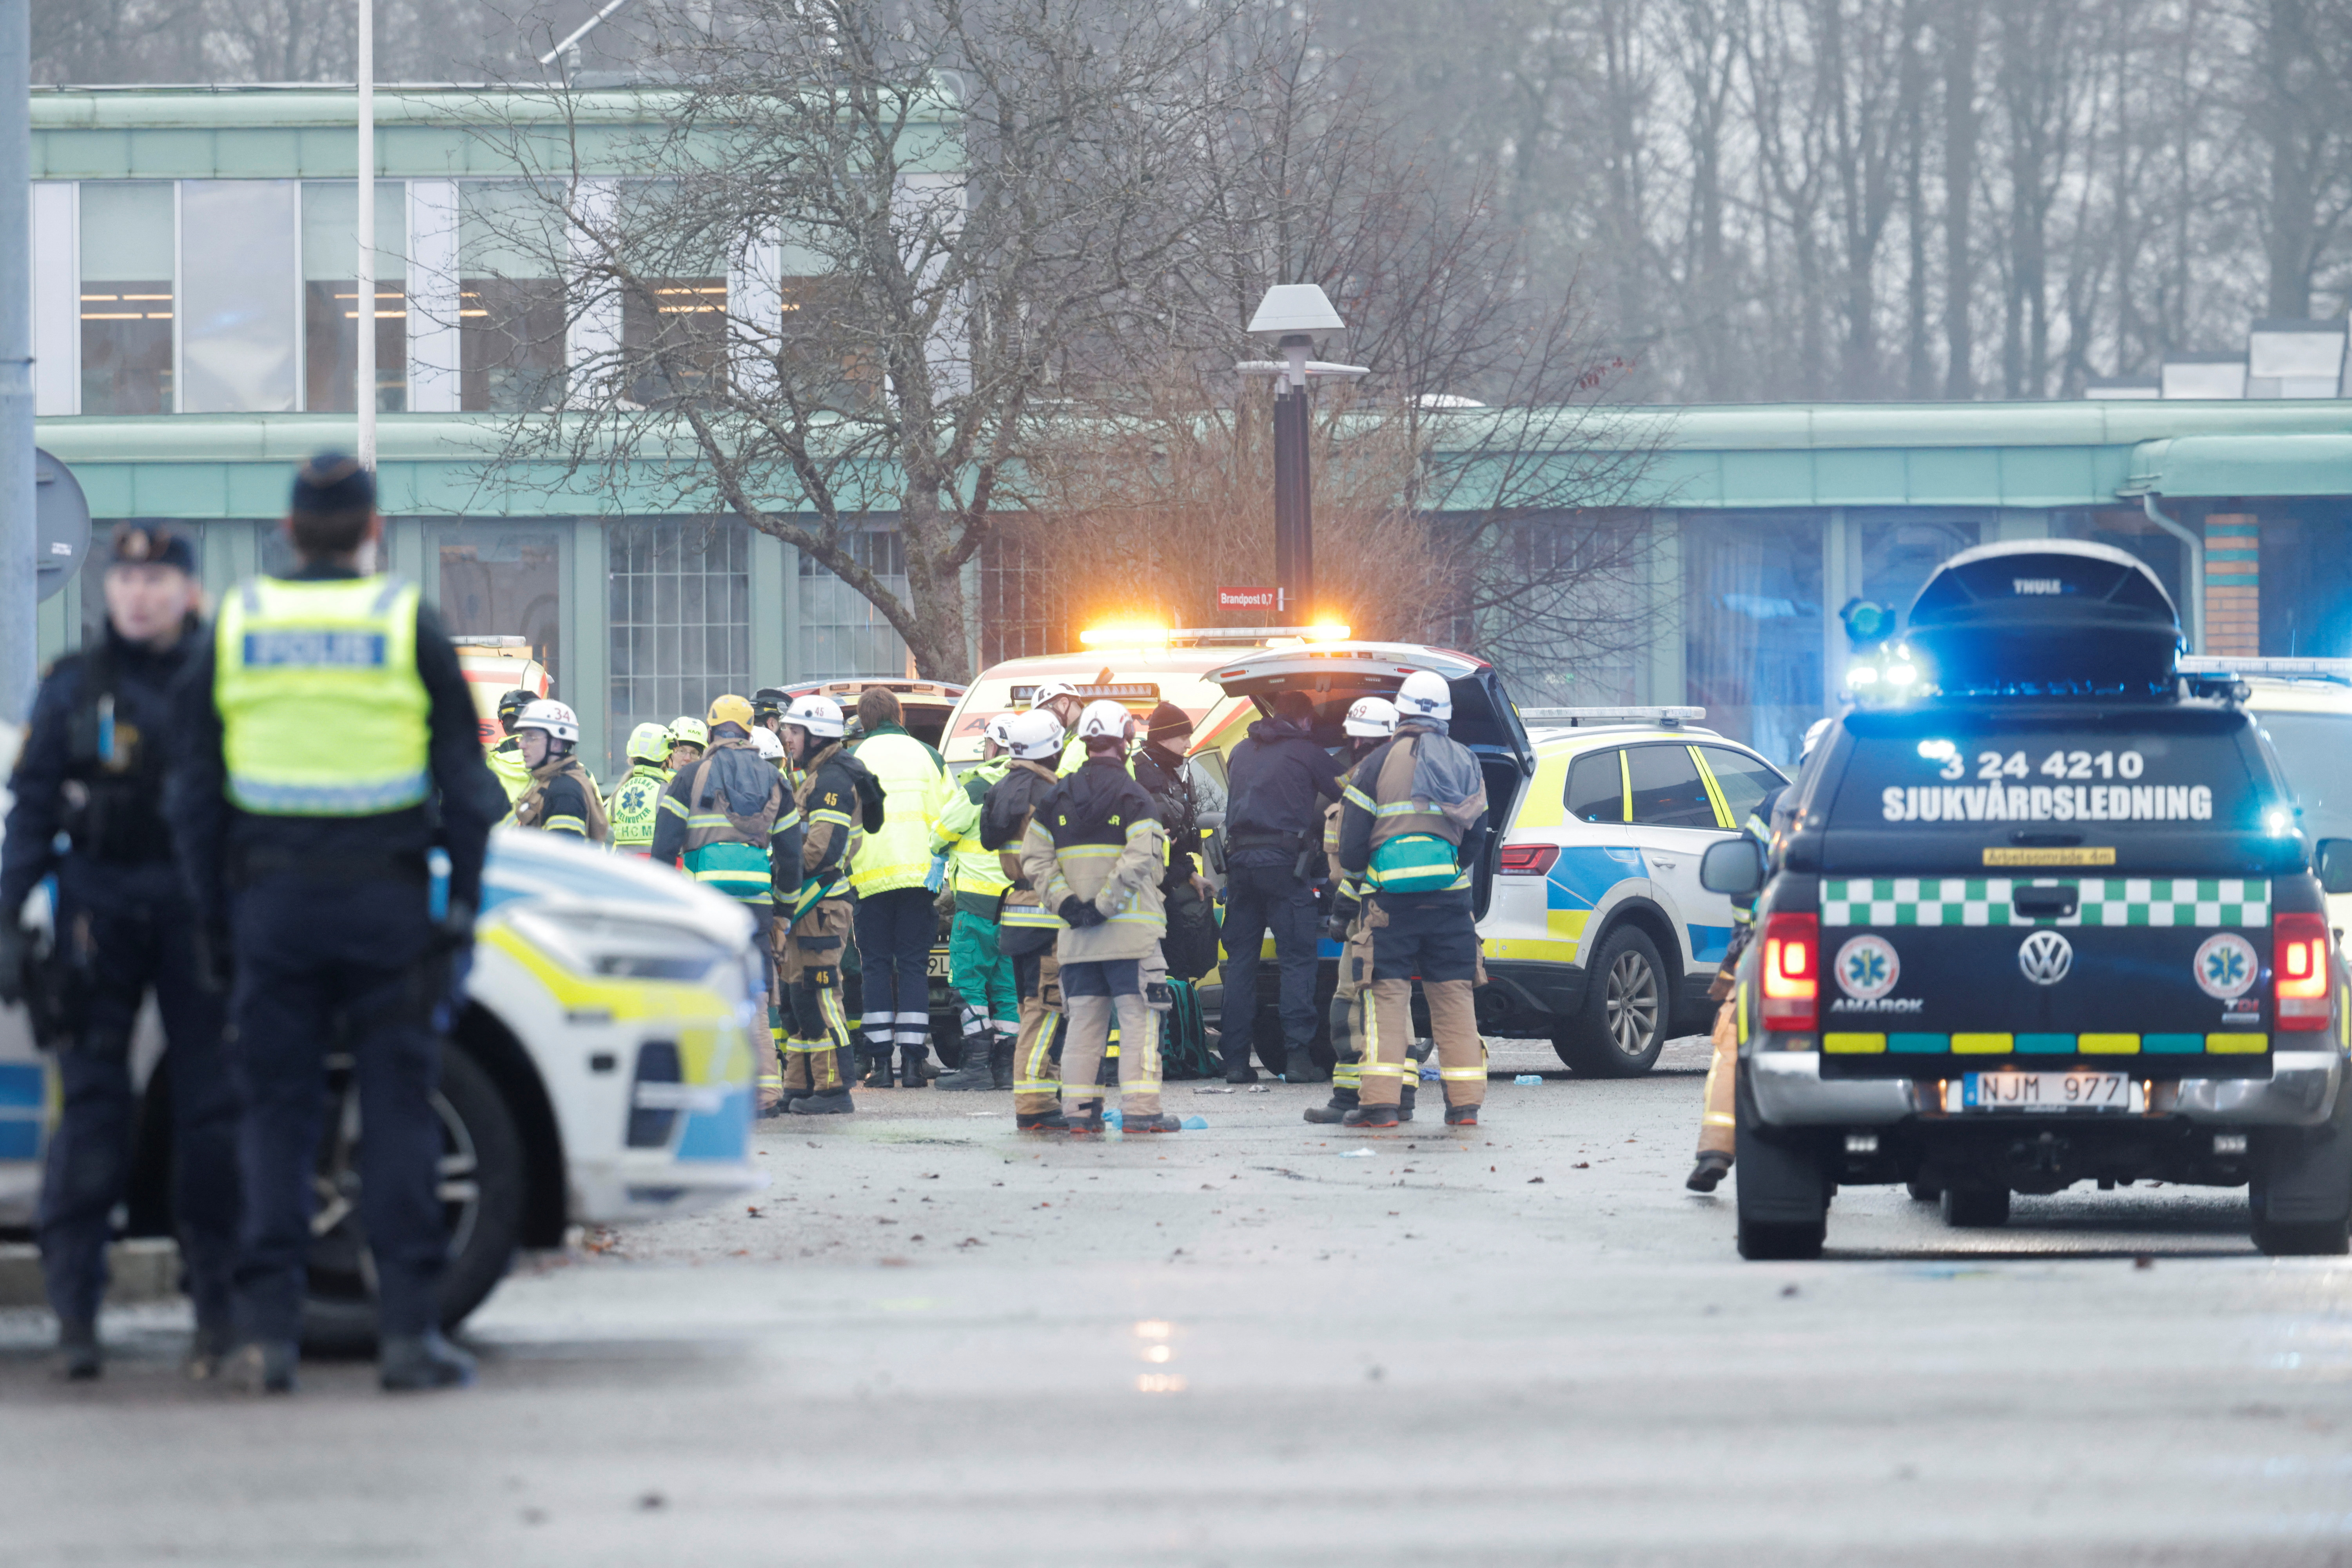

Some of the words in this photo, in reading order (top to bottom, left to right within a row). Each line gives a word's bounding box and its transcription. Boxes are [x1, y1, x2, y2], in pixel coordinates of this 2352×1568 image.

[2013, 578, 2061, 595] THULE
[1221, 593, 1260, 607] Brandpost
[1261, 593, 1273, 606] 0,7
[554, 708, 570, 722] 34
[815, 707, 824, 717] 45
[1352, 705, 1367, 717] 69
[1940, 752, 1965, 780] 3
[1977, 750, 2029, 779] 24
[2040, 750, 2144, 779] 4210
[824, 792, 838, 806] 45
[1882, 778, 2213, 821] SJUKVÅRDSLEDNING
[929, 957, 949, 975] 9L
[816, 971, 829, 984] 45
[1830, 998, 1924, 1013] AMAROK
[2224, 998, 2260, 1013] TDI
[1983, 1076, 2038, 1101] NJM
[2065, 1076, 2120, 1101] 977
